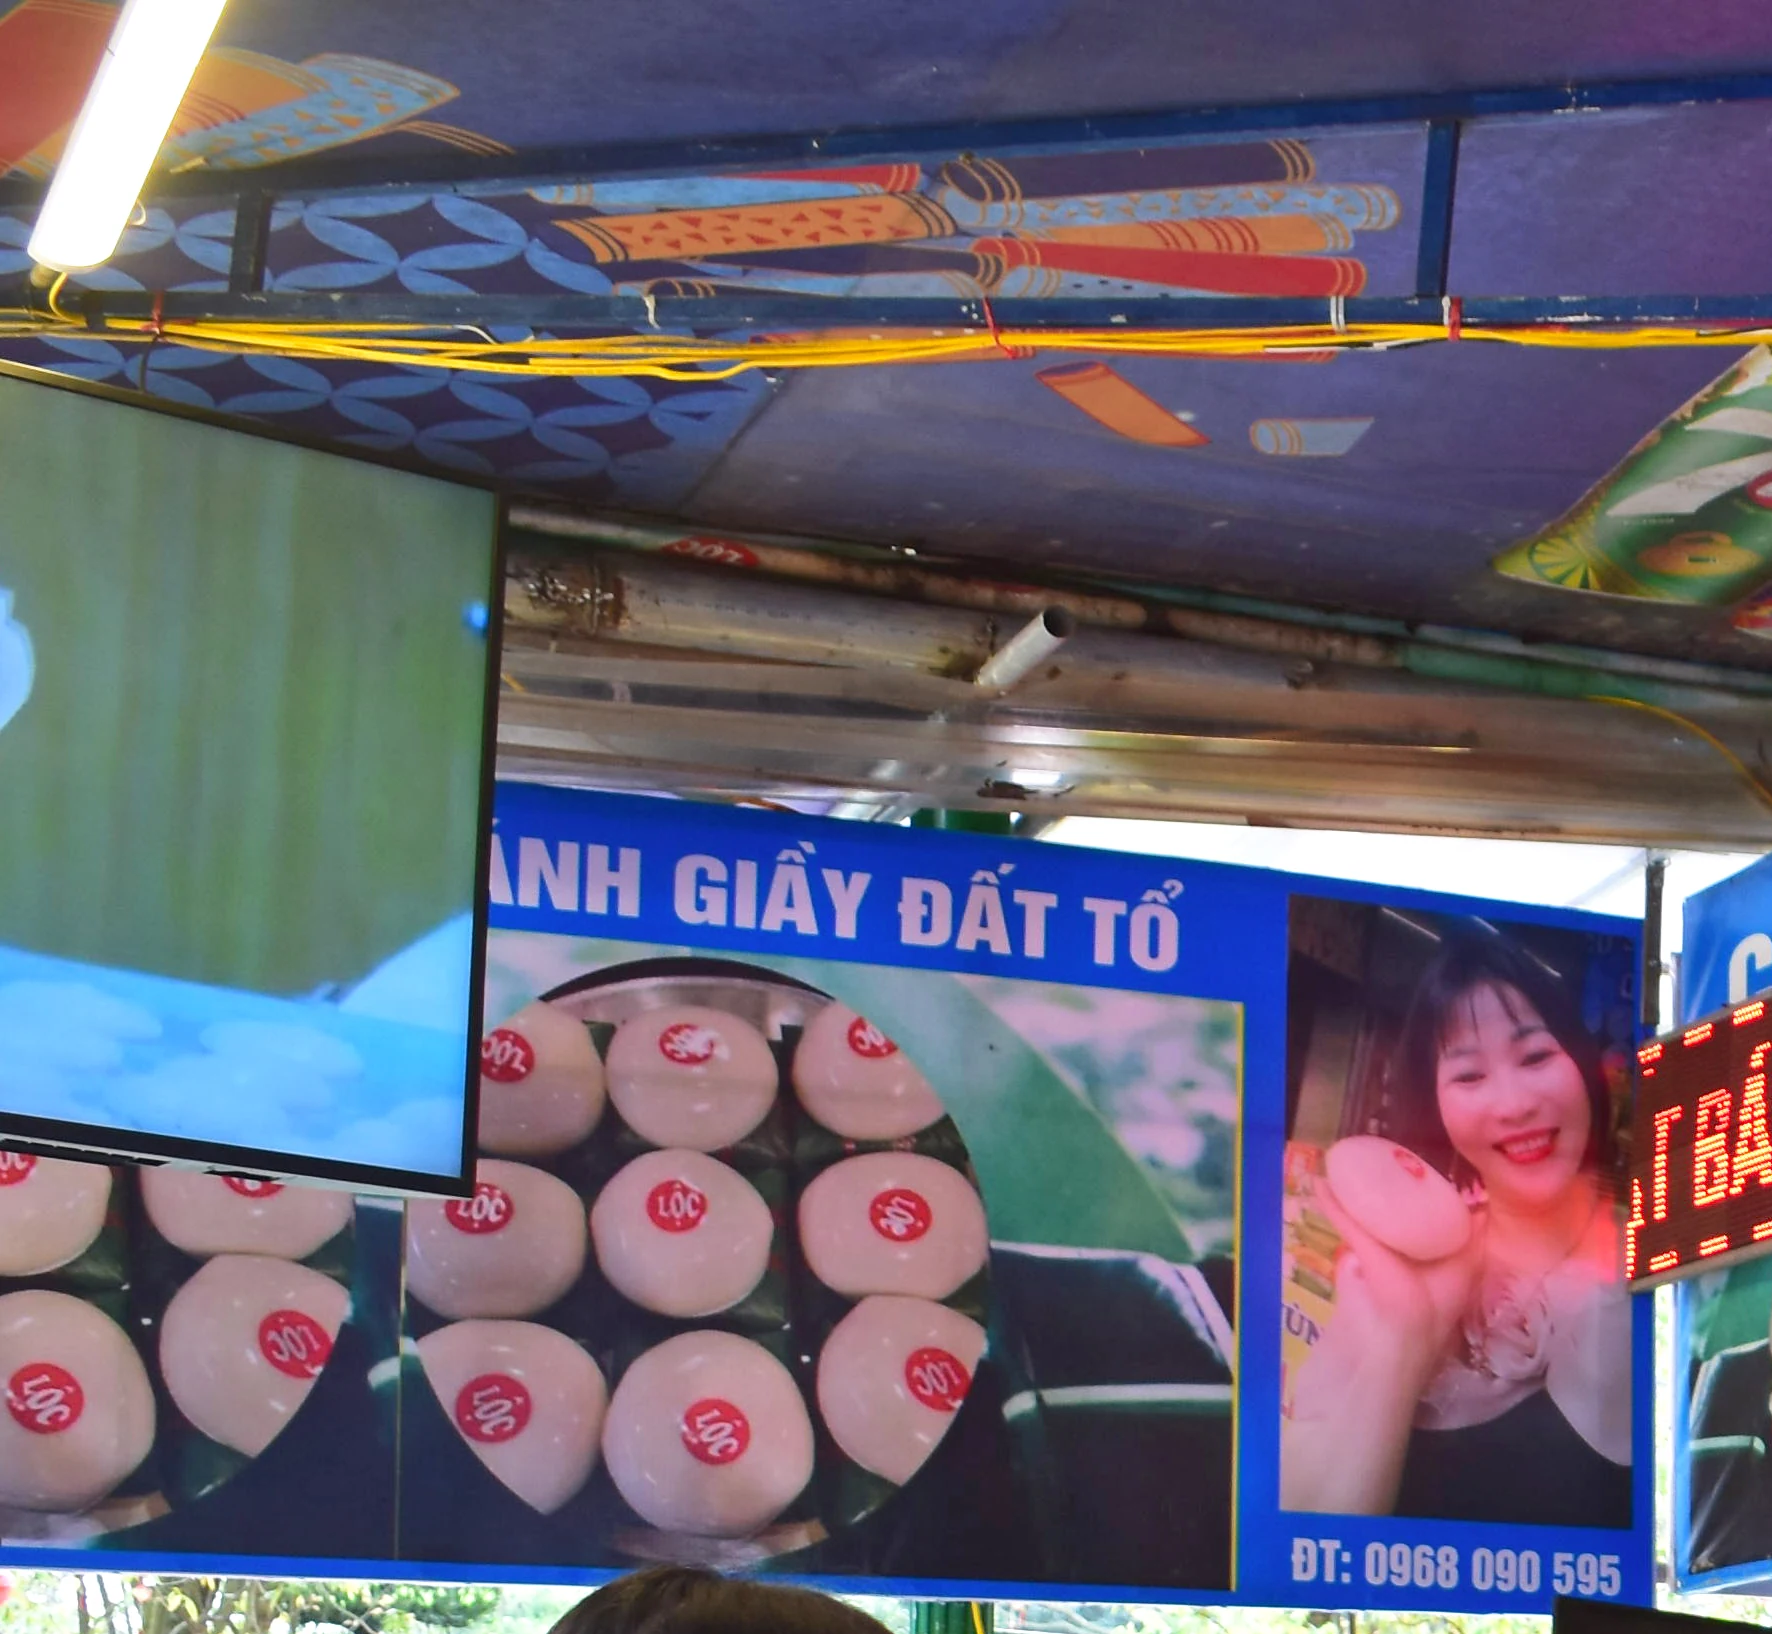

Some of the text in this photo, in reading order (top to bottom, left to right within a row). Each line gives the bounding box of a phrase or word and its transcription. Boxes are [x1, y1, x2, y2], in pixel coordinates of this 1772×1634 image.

[673, 840, 873, 939] GIẦY
[898, 864, 1058, 958] ĐẤT
[1084, 880, 1184, 972] TỔ
[655, 1182, 701, 1228] LỘC
[464, 1384, 526, 1435] LỘC
[681, 1408, 743, 1458] LỘC
[1292, 1538, 1621, 1597] ĐT: 0968 090 595
